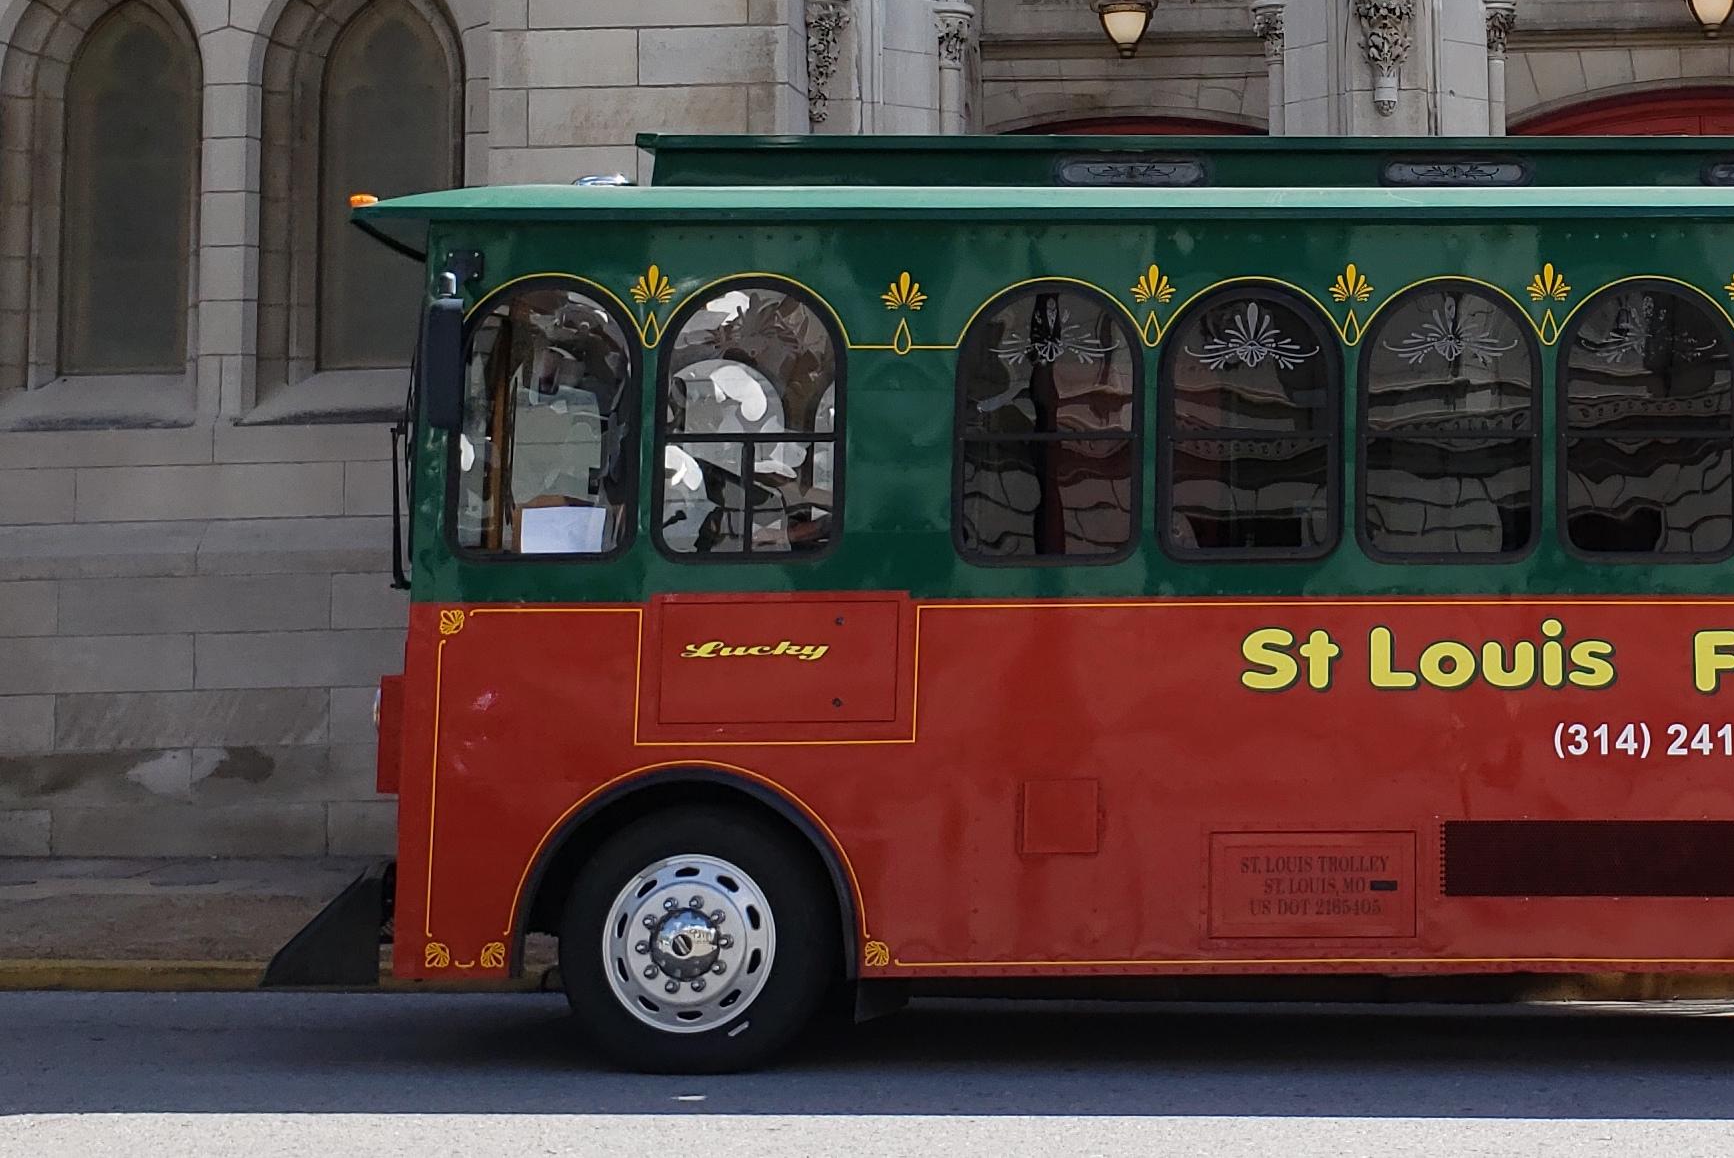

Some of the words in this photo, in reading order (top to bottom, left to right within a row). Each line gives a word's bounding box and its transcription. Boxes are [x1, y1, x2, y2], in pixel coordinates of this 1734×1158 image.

[680, 640, 830, 662] Lucky
[1240, 627, 1341, 692] St
[1369, 618, 1616, 690] Louis
[1553, 722, 1652, 759] (314)
[1264, 856, 1313, 874] LOUIS
[1316, 855, 1390, 873] TROLLEY
[1343, 876, 1367, 894] MO
[1248, 898, 1272, 916] US
[1277, 898, 1311, 916] DOT
